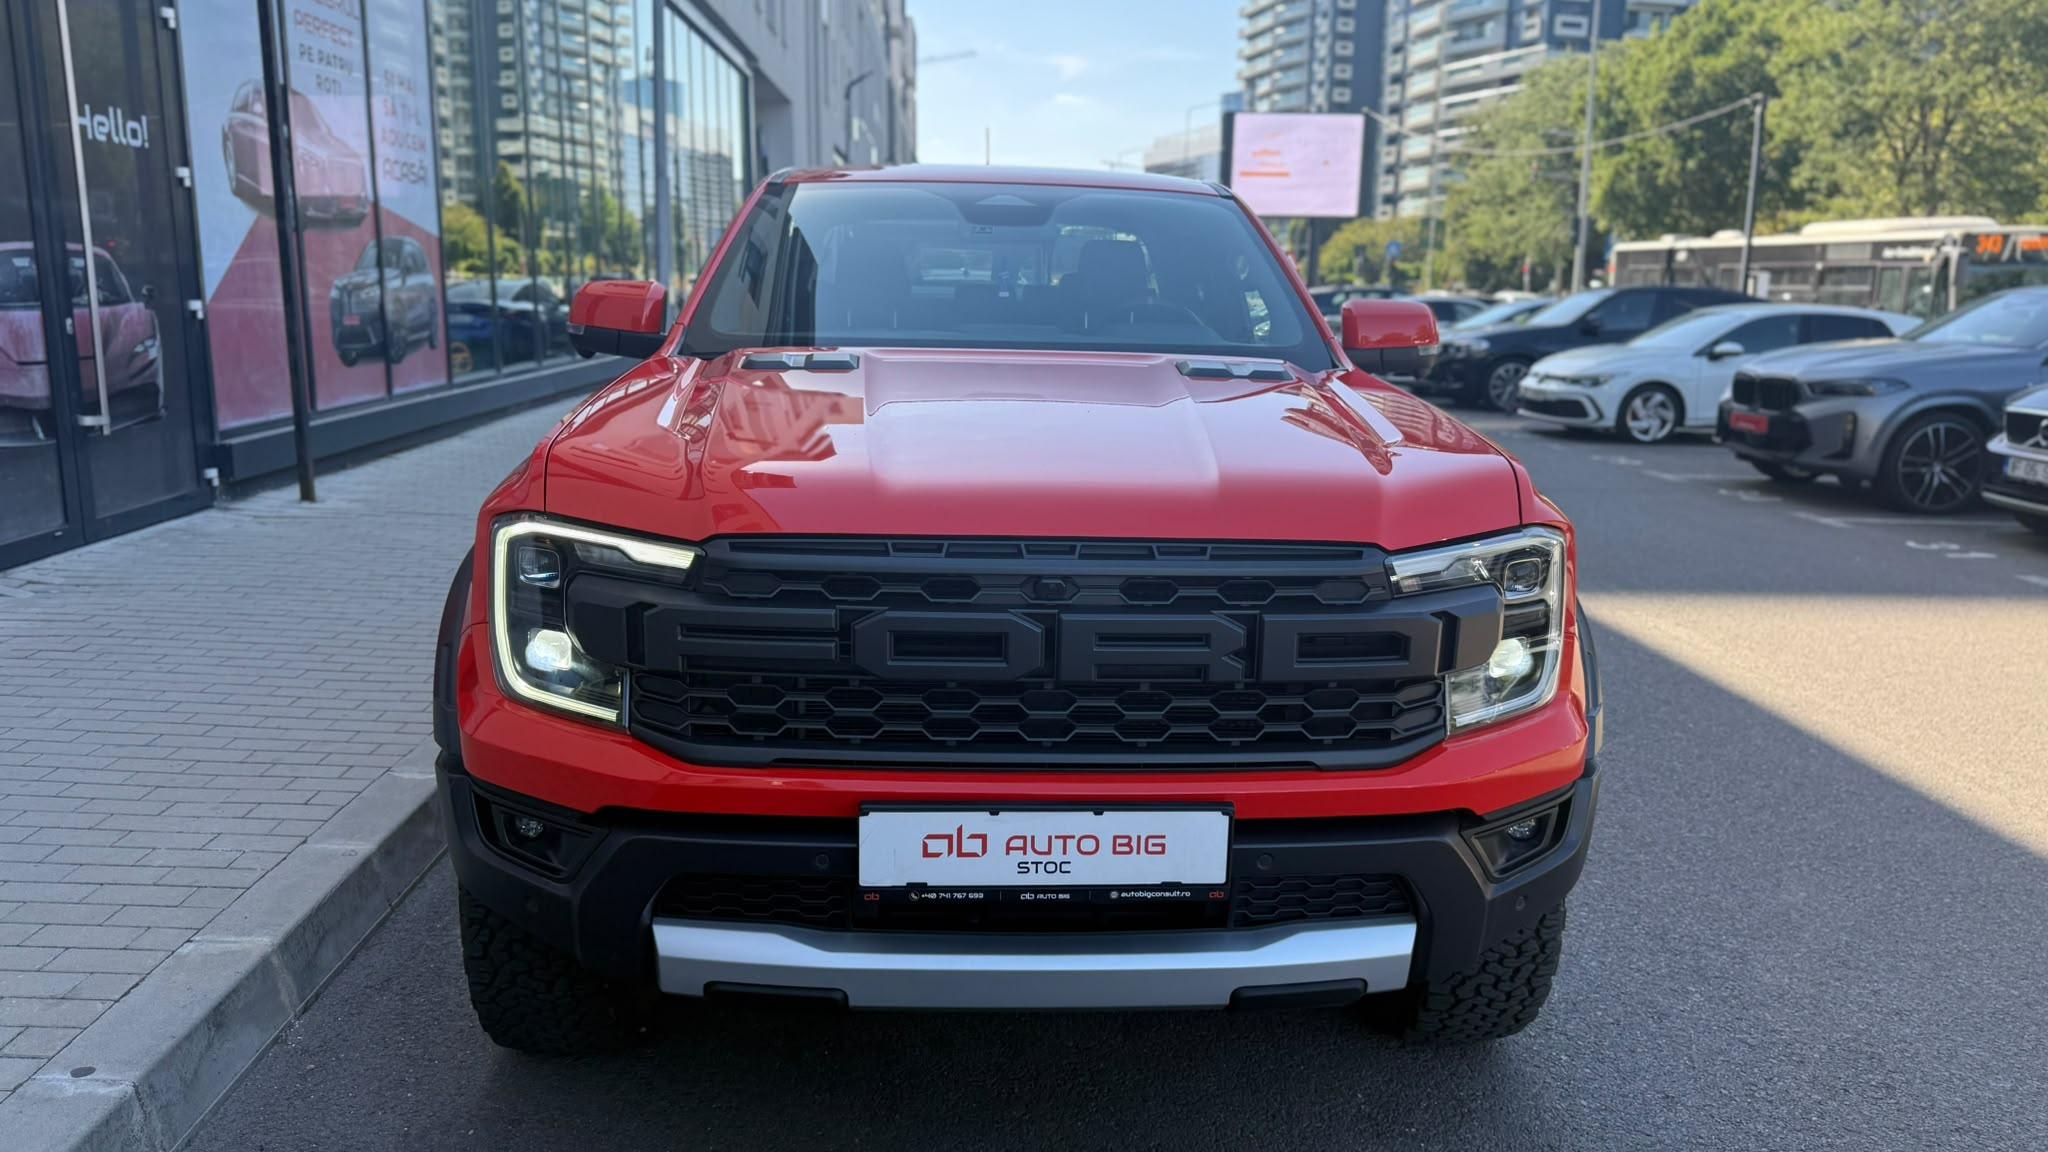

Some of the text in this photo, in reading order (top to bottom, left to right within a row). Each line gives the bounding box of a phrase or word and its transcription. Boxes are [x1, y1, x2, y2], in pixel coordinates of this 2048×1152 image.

[77, 103, 149, 149] Hello!
[643, 603, 1442, 684] FORD
[1005, 834, 1100, 856] AUTO
[1112, 834, 1167, 856] BIG
[1016, 861, 1072, 875] STOC
[953, 892, 967, 900] 767
[1120, 889, 1191, 900] autobigconsult.ro
